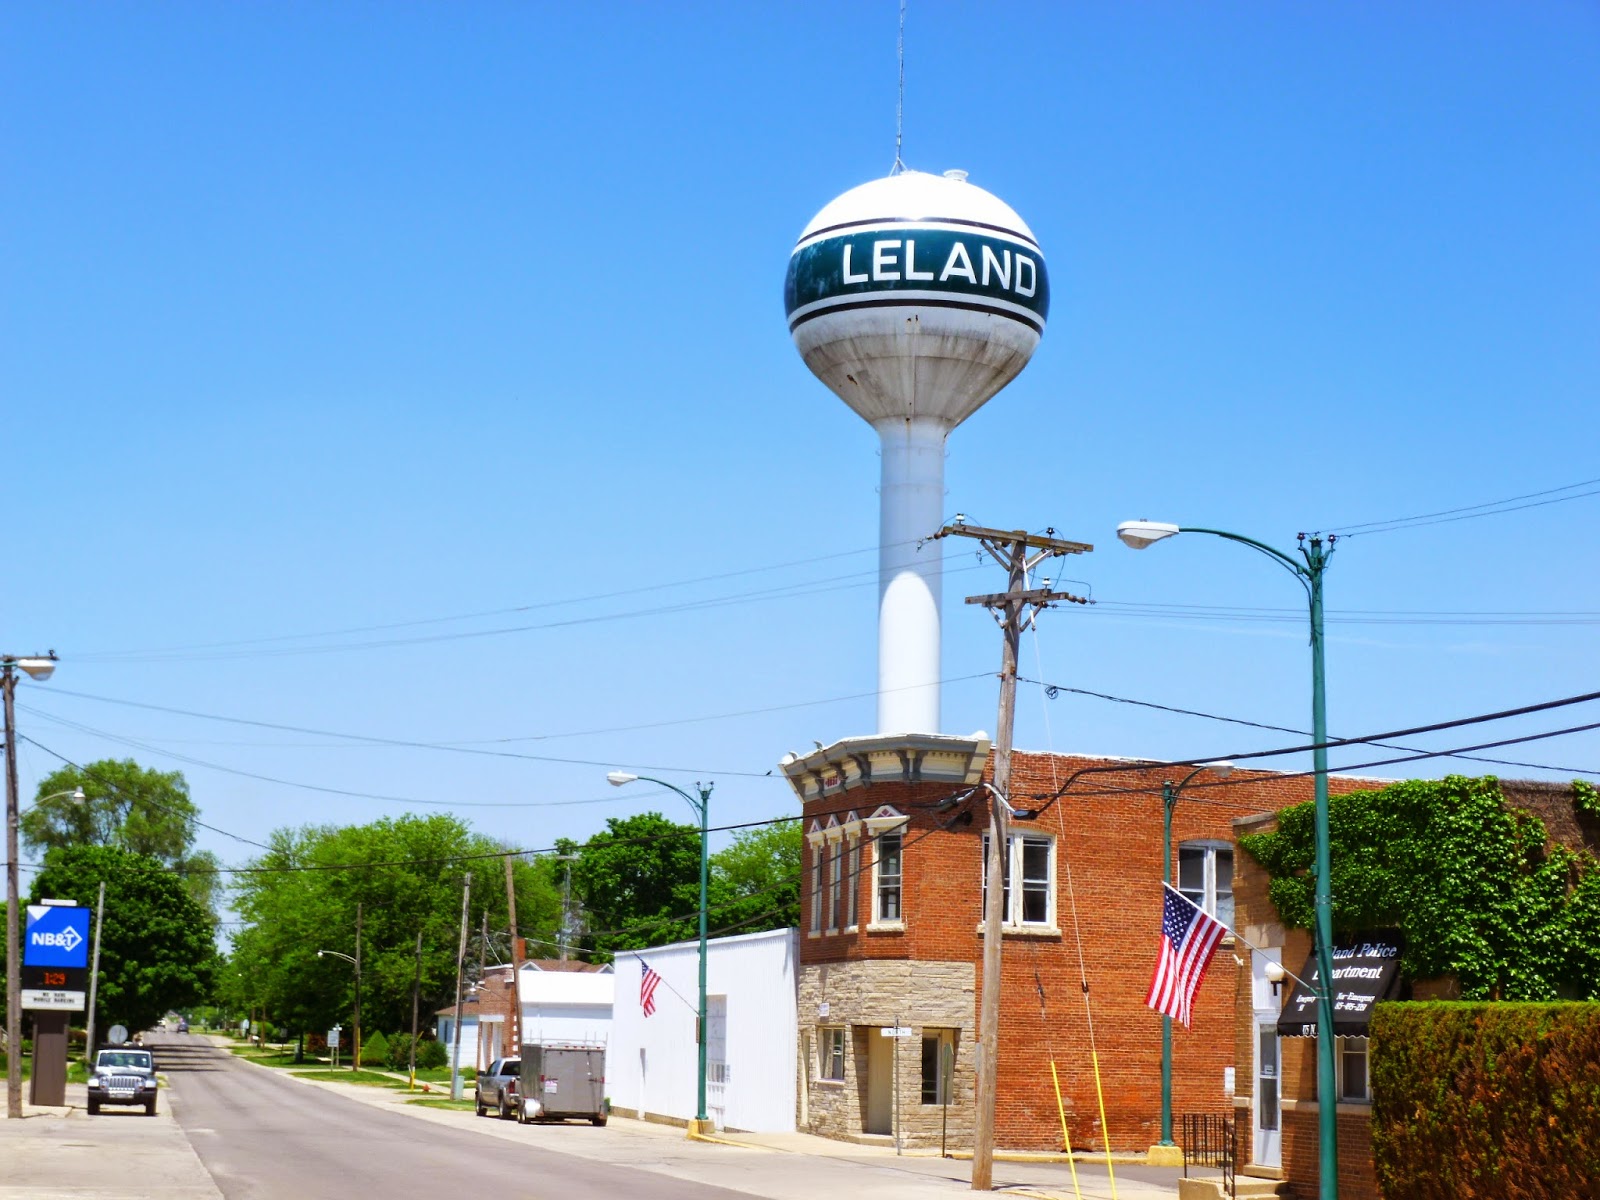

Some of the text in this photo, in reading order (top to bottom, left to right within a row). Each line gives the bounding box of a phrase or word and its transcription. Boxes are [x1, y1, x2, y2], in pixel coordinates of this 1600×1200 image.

[843, 239, 1037, 298] LELAND
[32, 932, 74, 946] NB&T
[1357, 943, 1397, 958] Police
[1312, 966, 1383, 980] artment
